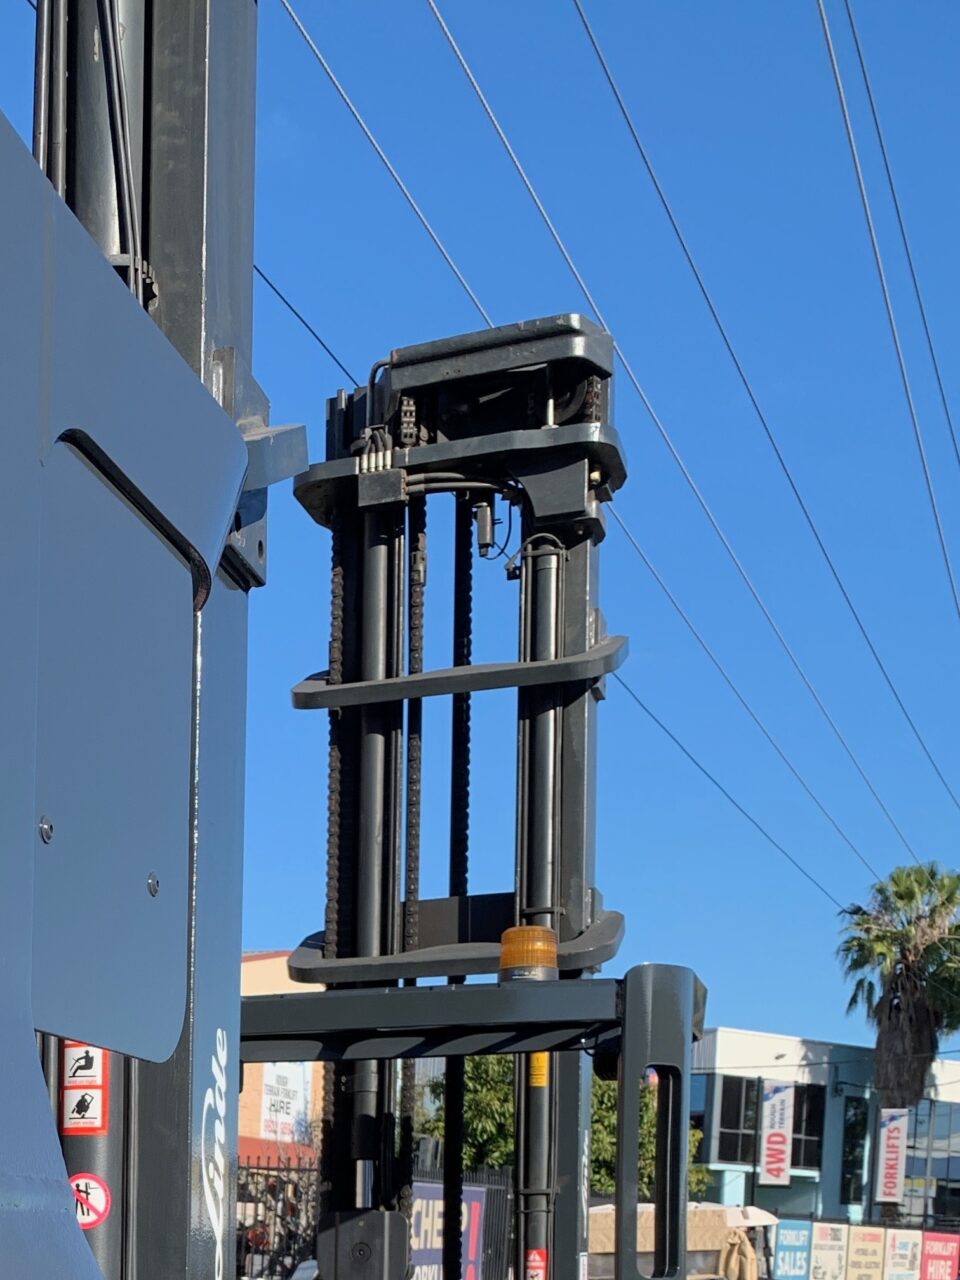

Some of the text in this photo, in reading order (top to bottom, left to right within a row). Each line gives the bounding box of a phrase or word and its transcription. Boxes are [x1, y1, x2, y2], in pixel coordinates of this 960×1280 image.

[269, 1098, 291, 1115] HIRE
[766, 1131, 787, 1179] 4WD
[883, 1126, 901, 1197] FORKLIFTS
[776, 1251, 808, 1276] SALES
[927, 1260, 952, 1280] HIRE
